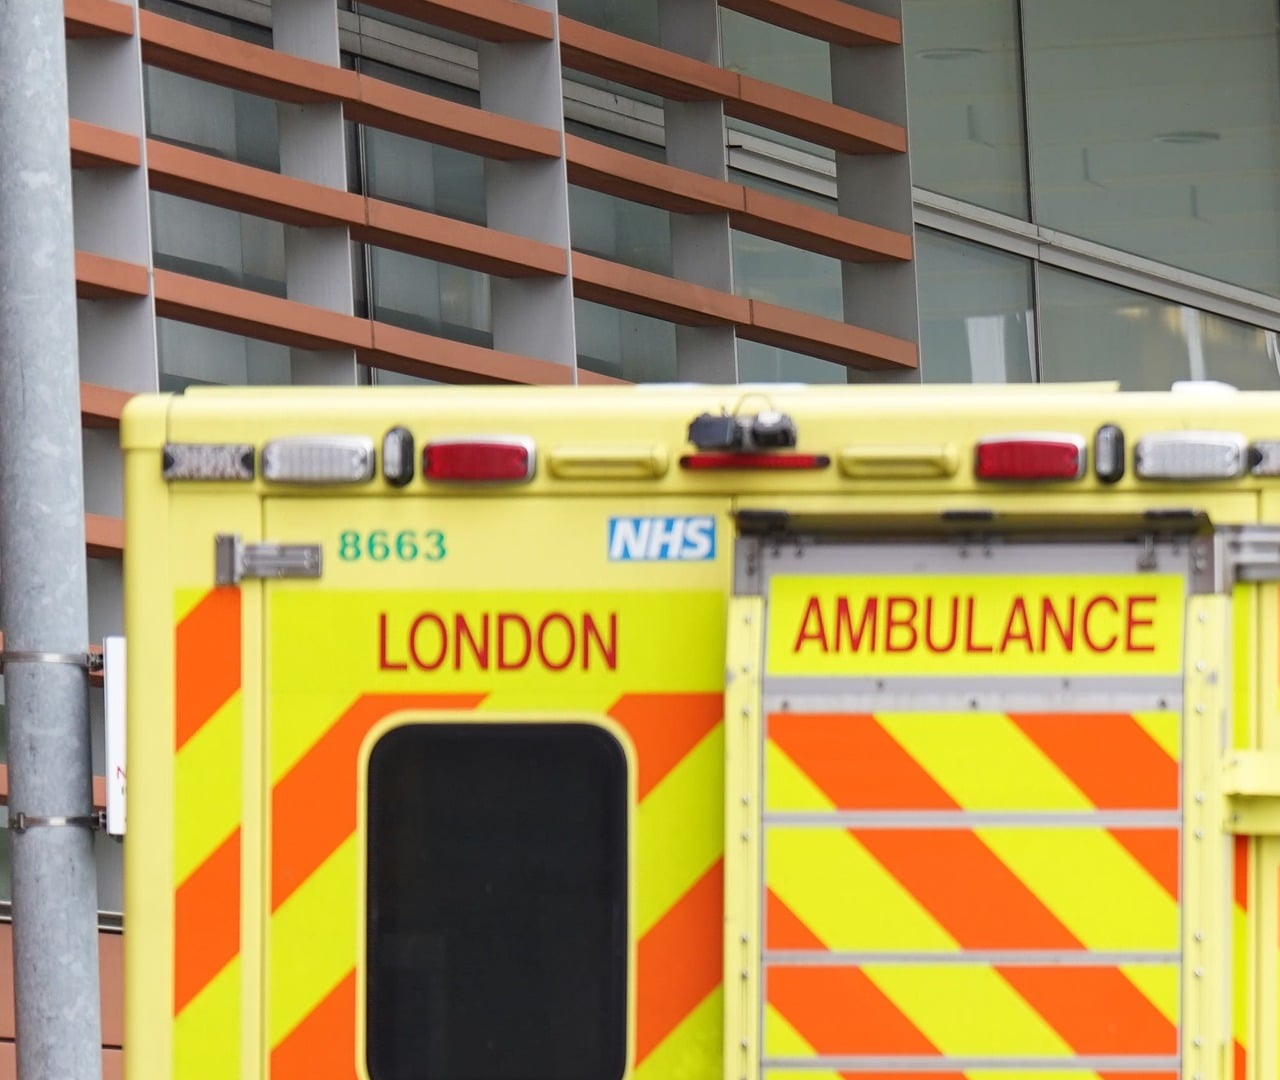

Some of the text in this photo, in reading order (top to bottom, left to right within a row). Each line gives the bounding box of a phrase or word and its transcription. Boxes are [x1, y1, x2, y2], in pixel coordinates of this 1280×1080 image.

[338, 530, 447, 562] 8663
[610, 518, 715, 559] NHS
[378, 611, 618, 672] LONDON
[794, 595, 1158, 654] AMBULANCE
